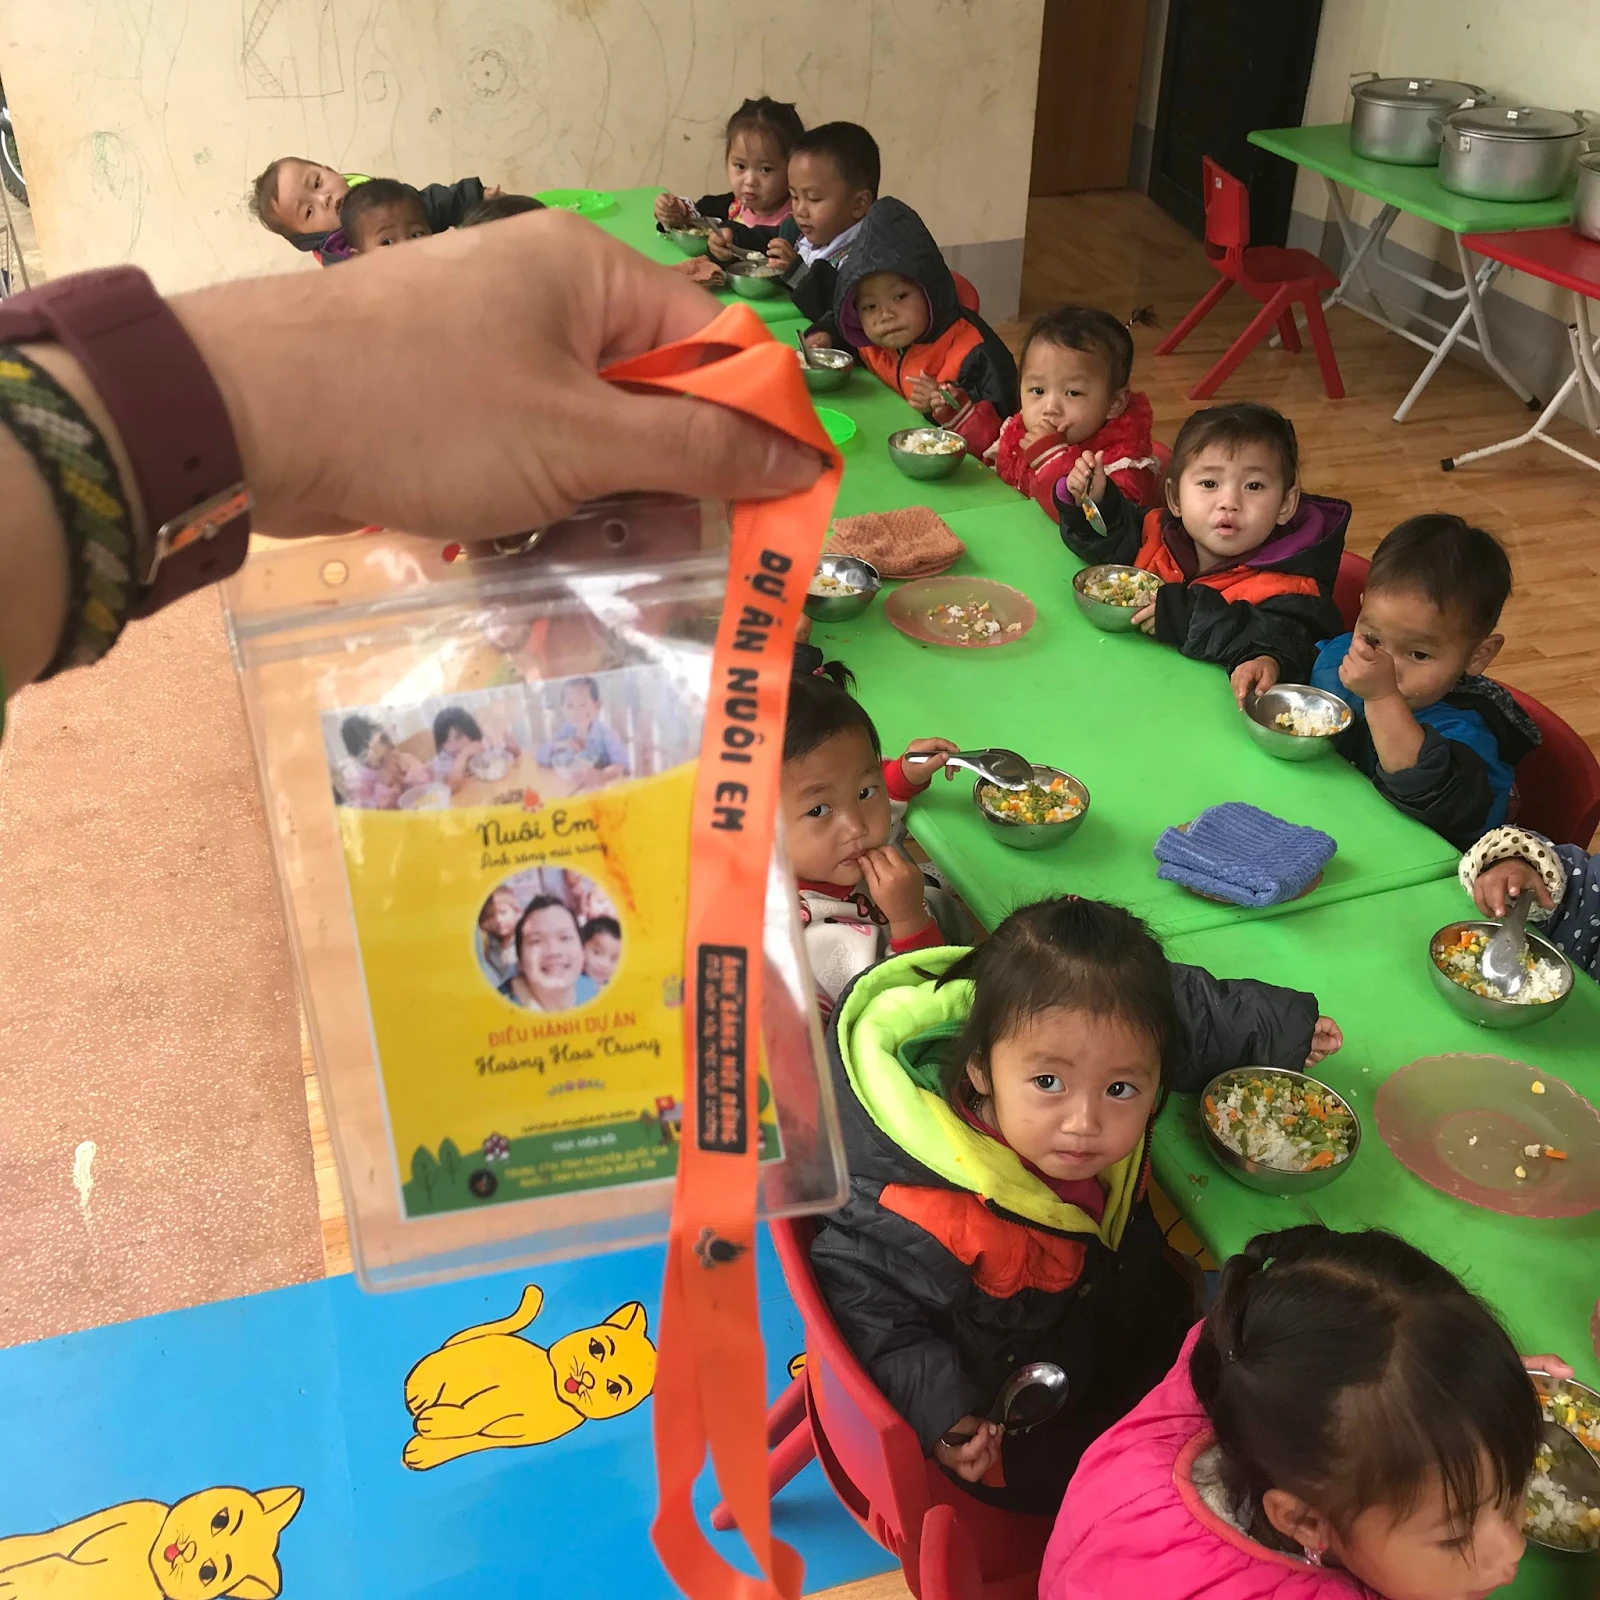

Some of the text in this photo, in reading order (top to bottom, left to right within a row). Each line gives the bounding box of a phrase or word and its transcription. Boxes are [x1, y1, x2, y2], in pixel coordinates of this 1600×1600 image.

[732, 604, 783, 654] ÁN
[720, 667, 765, 763] NUÔI
[475, 809, 599, 848] Nuôi Em
[711, 781, 749, 832] EM
[548, 1042, 595, 1064] Hoa
[596, 1035, 662, 1057] Trung
